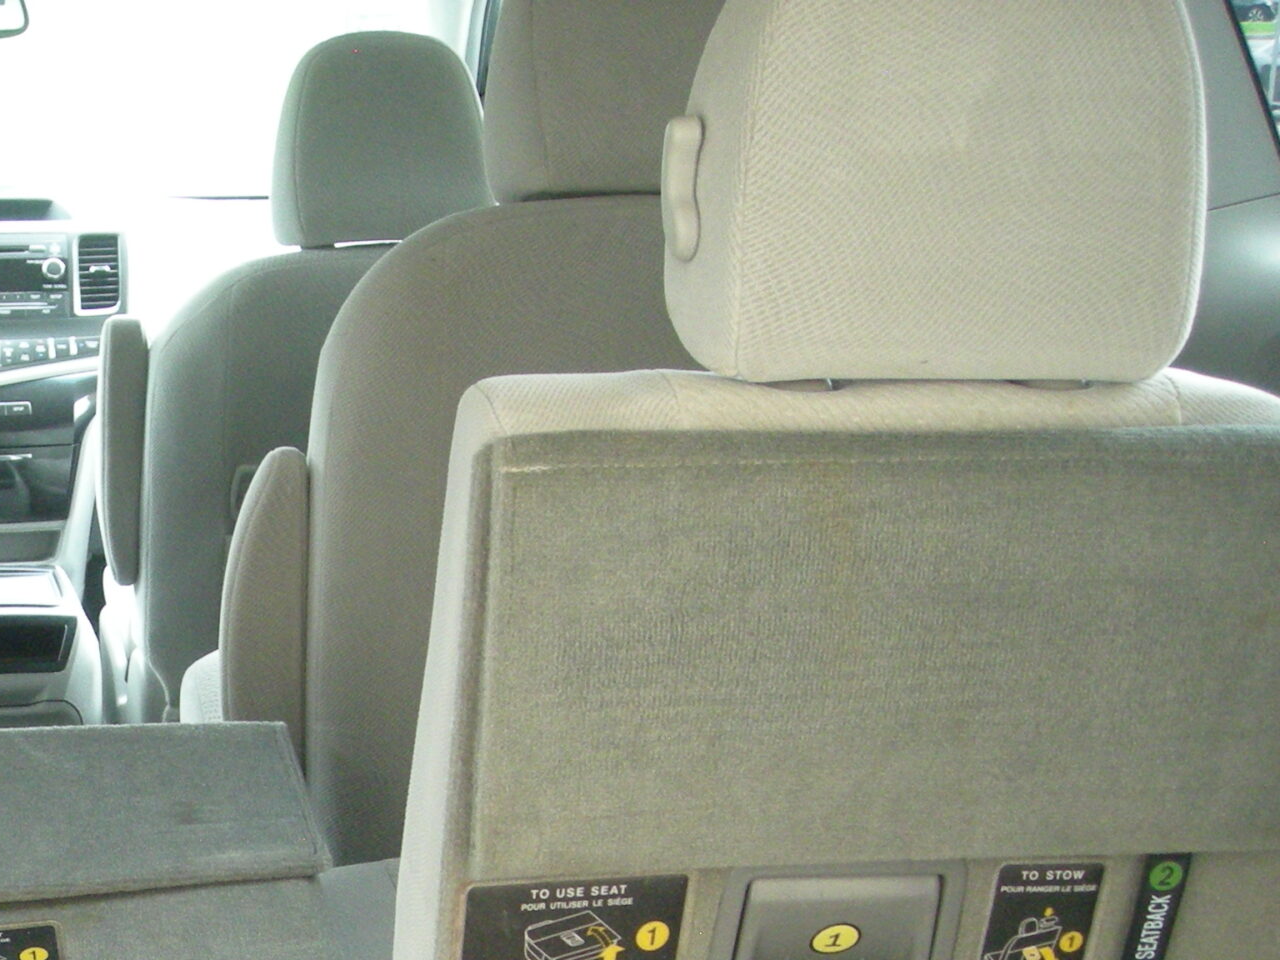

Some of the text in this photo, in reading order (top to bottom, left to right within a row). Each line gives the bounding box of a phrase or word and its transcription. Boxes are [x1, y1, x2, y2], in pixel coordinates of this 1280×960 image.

[1021, 869, 1085, 881] TO STOW
[1159, 866, 1174, 886] 2
[530, 884, 627, 900] TO USE SEAT
[1001, 885, 1025, 893] POUR
[1026, 885, 1060, 893] RANGER
[521, 903, 546, 912] POUR
[550, 900, 588, 910] UTILISER
[592, 898, 602, 907] LE
[1135, 895, 1171, 960] SEATBACK
[647, 926, 656, 946] 1
[825, 932, 841, 947] 1
[29, 951, 36, 960] 1
